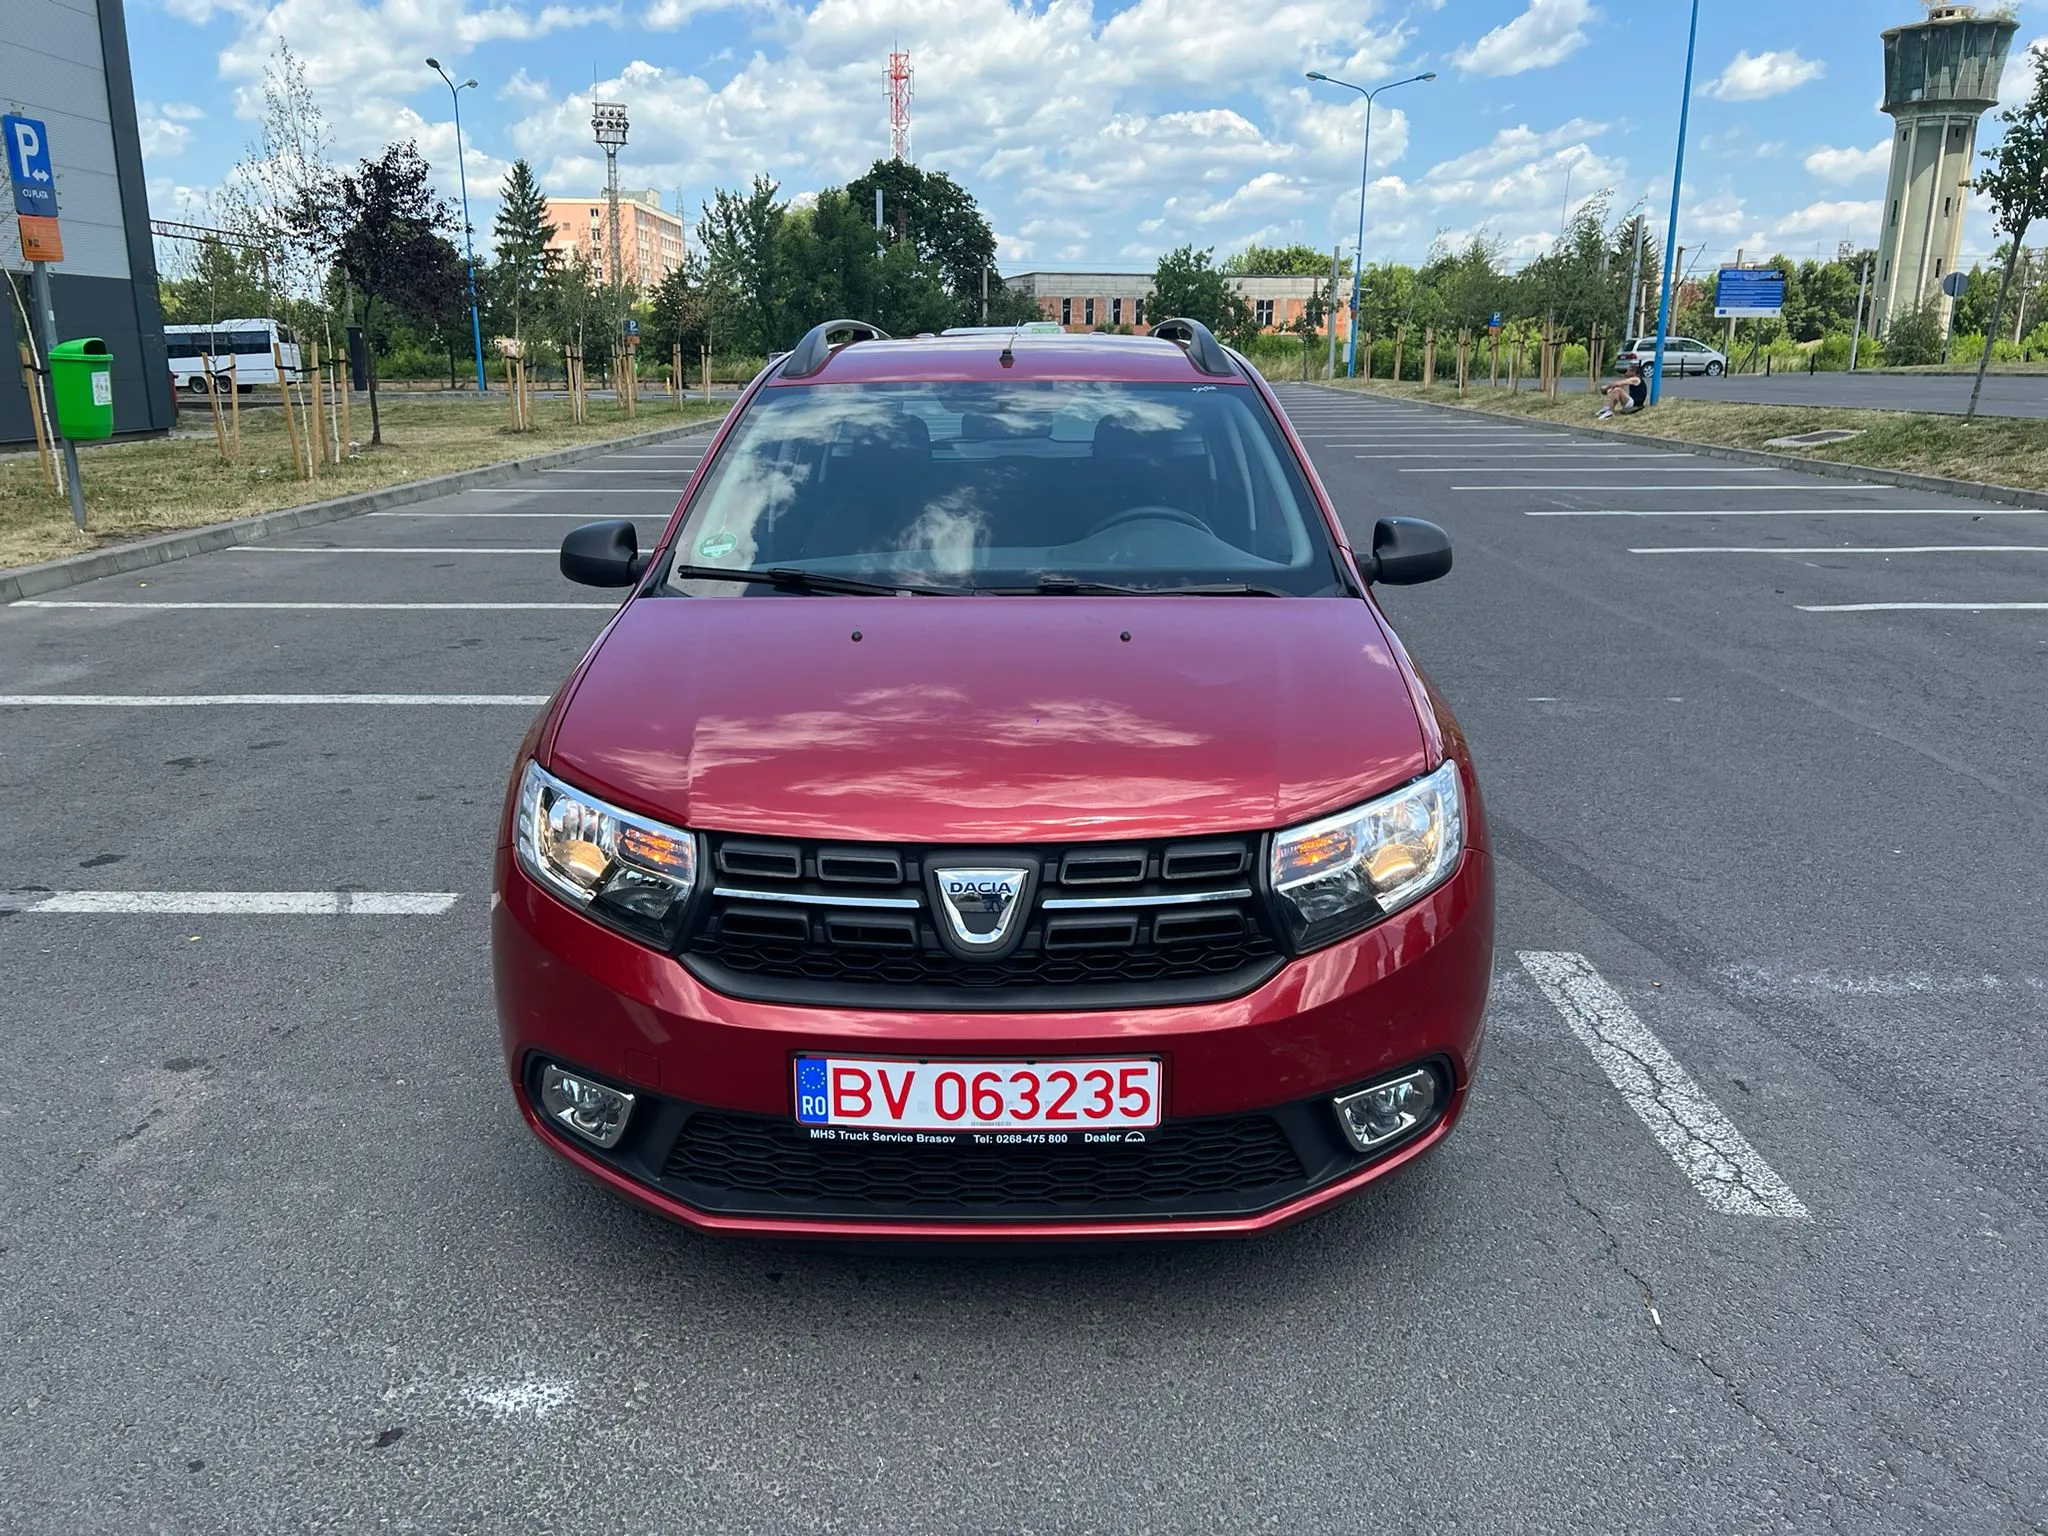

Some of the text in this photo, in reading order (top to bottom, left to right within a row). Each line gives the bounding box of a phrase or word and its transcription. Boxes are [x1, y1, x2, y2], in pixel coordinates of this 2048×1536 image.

[14, 123, 40, 178] P
[950, 882, 1012, 893] DACIA
[832, 1067, 1151, 1121] BV 063235
[802, 1095, 826, 1116] RO
[810, 1129, 836, 1140] MHS
[838, 1131, 870, 1142] Truck
[872, 1133, 914, 1143] Service
[916, 1134, 956, 1144] Brasov
[973, 1134, 993, 1144] Tel:
[996, 1134, 1046, 1144] 0268-475
[1048, 1134, 1068, 1144] 800
[1084, 1133, 1121, 1143] Dealer
